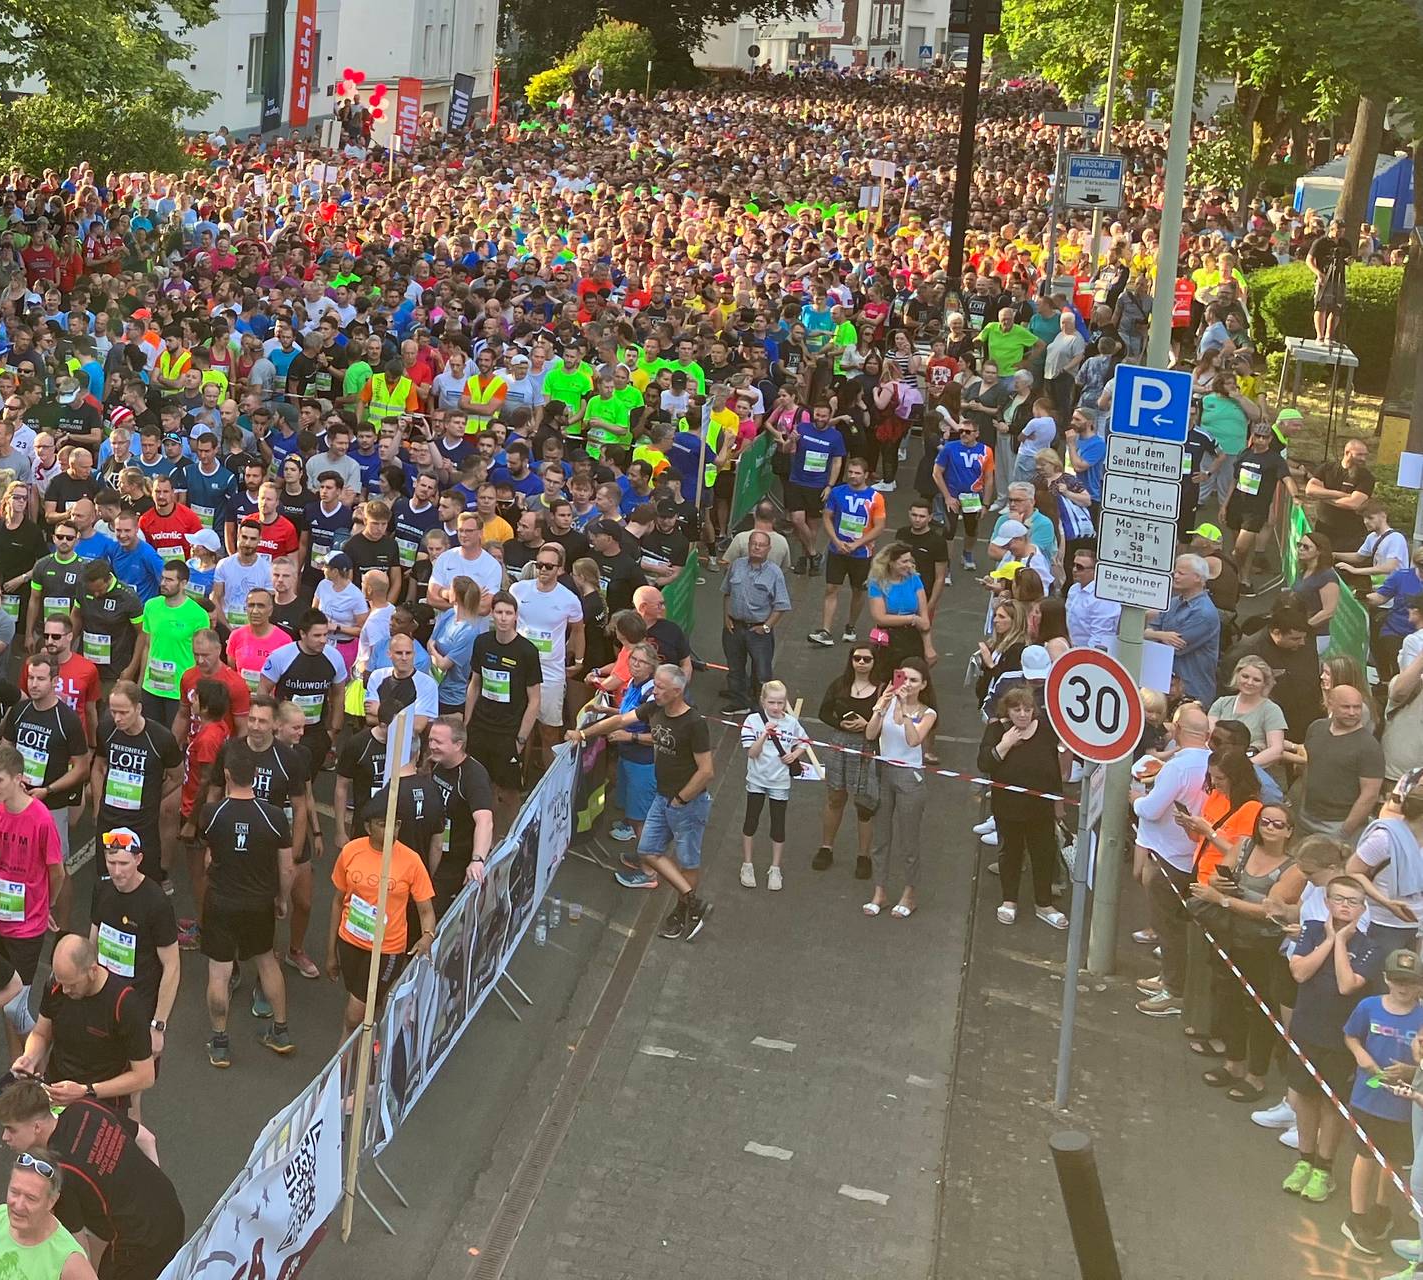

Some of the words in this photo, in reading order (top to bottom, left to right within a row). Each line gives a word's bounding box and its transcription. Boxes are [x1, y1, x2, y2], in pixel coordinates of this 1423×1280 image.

[1072, 159, 1119, 169] PARKSCHEIN-
[1079, 169, 1111, 178] AUTOMAT
[1129, 376, 1172, 427] P
[1125, 445, 1140, 457] auf
[1145, 447, 1164, 459] dem
[1112, 455, 1176, 474] Seitenstreifen
[1133, 486, 1151, 497] mit
[1109, 494, 1173, 512] Parkschein
[1116, 517, 1132, 529] Mo
[1147, 523, 1159, 533] Fr
[151, 531, 182, 540] valantic
[1129, 542, 1143, 552] Sa
[1105, 570, 1162, 589] Bewohner
[1066, 675, 1120, 734] 30
[20, 722, 53, 735] FRIEDHELM
[16, 728, 50, 750] LOH
[110, 743, 148, 755] FRIEDHELM
[109, 750, 146, 771] LOH
